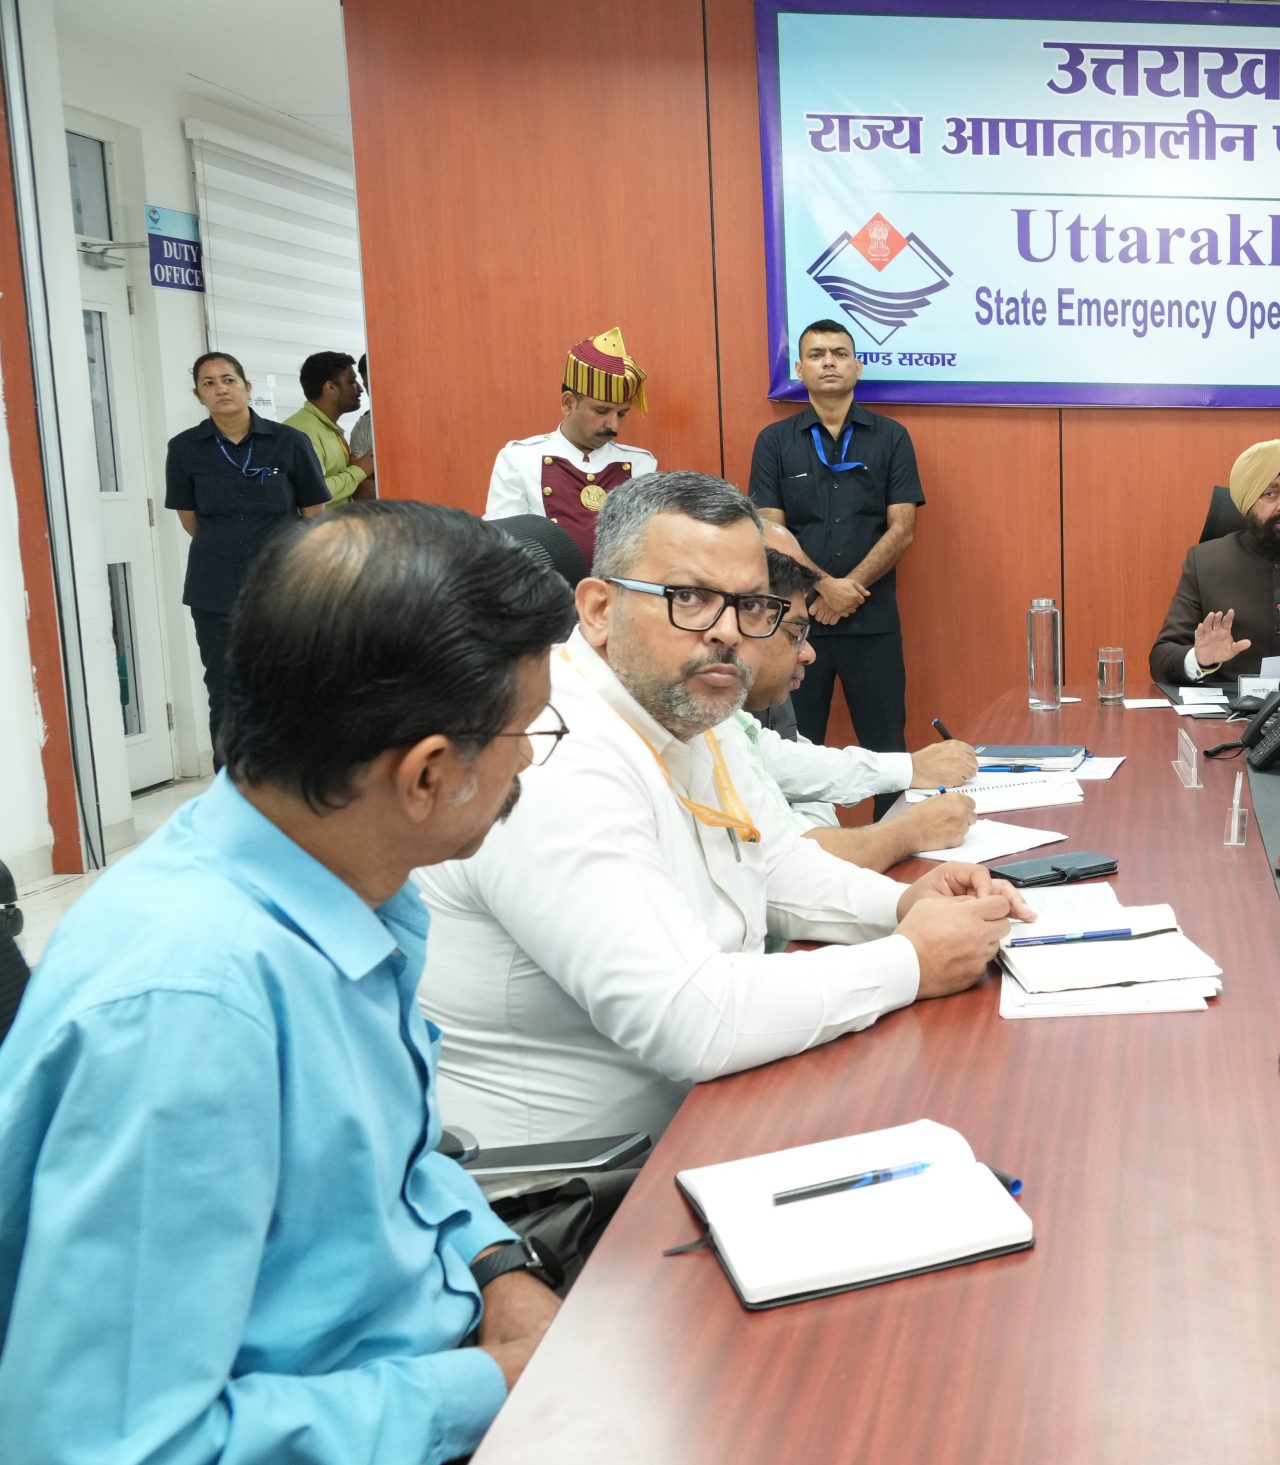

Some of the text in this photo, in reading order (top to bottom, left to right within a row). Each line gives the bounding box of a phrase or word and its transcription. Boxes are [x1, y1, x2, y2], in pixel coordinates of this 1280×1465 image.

[805, 113, 924, 155] राज्य
[941, 108, 1258, 163] आपातकालीन
[163, 240, 199, 262] DUTY
[974, 286, 1047, 327] State
[1057, 287, 1218, 340] Emergency
[897, 352, 957, 367] सरकार
